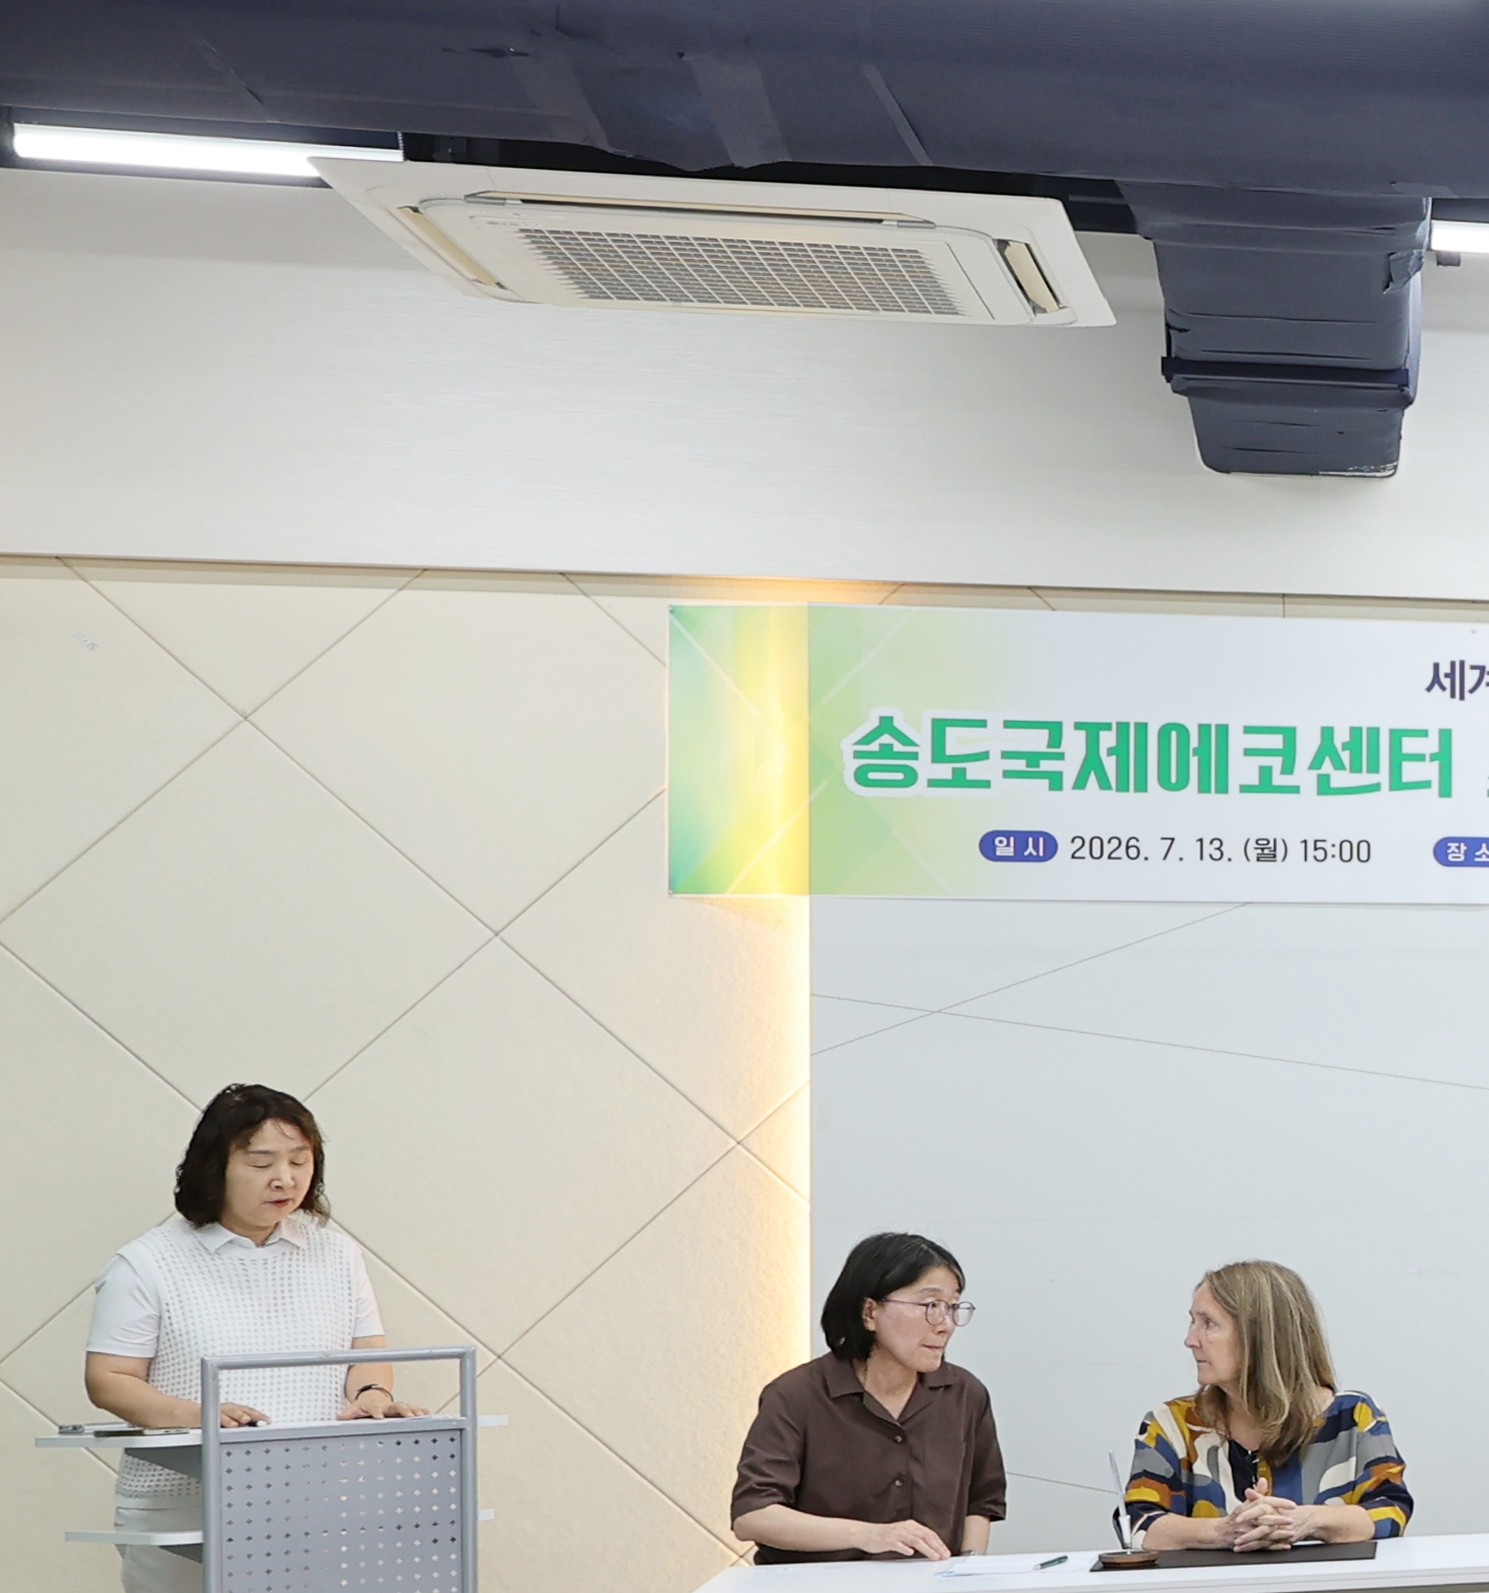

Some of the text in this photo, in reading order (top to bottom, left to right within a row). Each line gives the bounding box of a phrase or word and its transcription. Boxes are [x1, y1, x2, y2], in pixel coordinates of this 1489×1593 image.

[848, 716, 1453, 798] 송도국제에코센터
[1070, 835, 1149, 861] 2026.
[1160, 836, 1184, 862] 7.
[1196, 837, 1232, 862] 13.
[1243, 837, 1288, 863] (월)
[1300, 839, 1371, 864] 15:00
